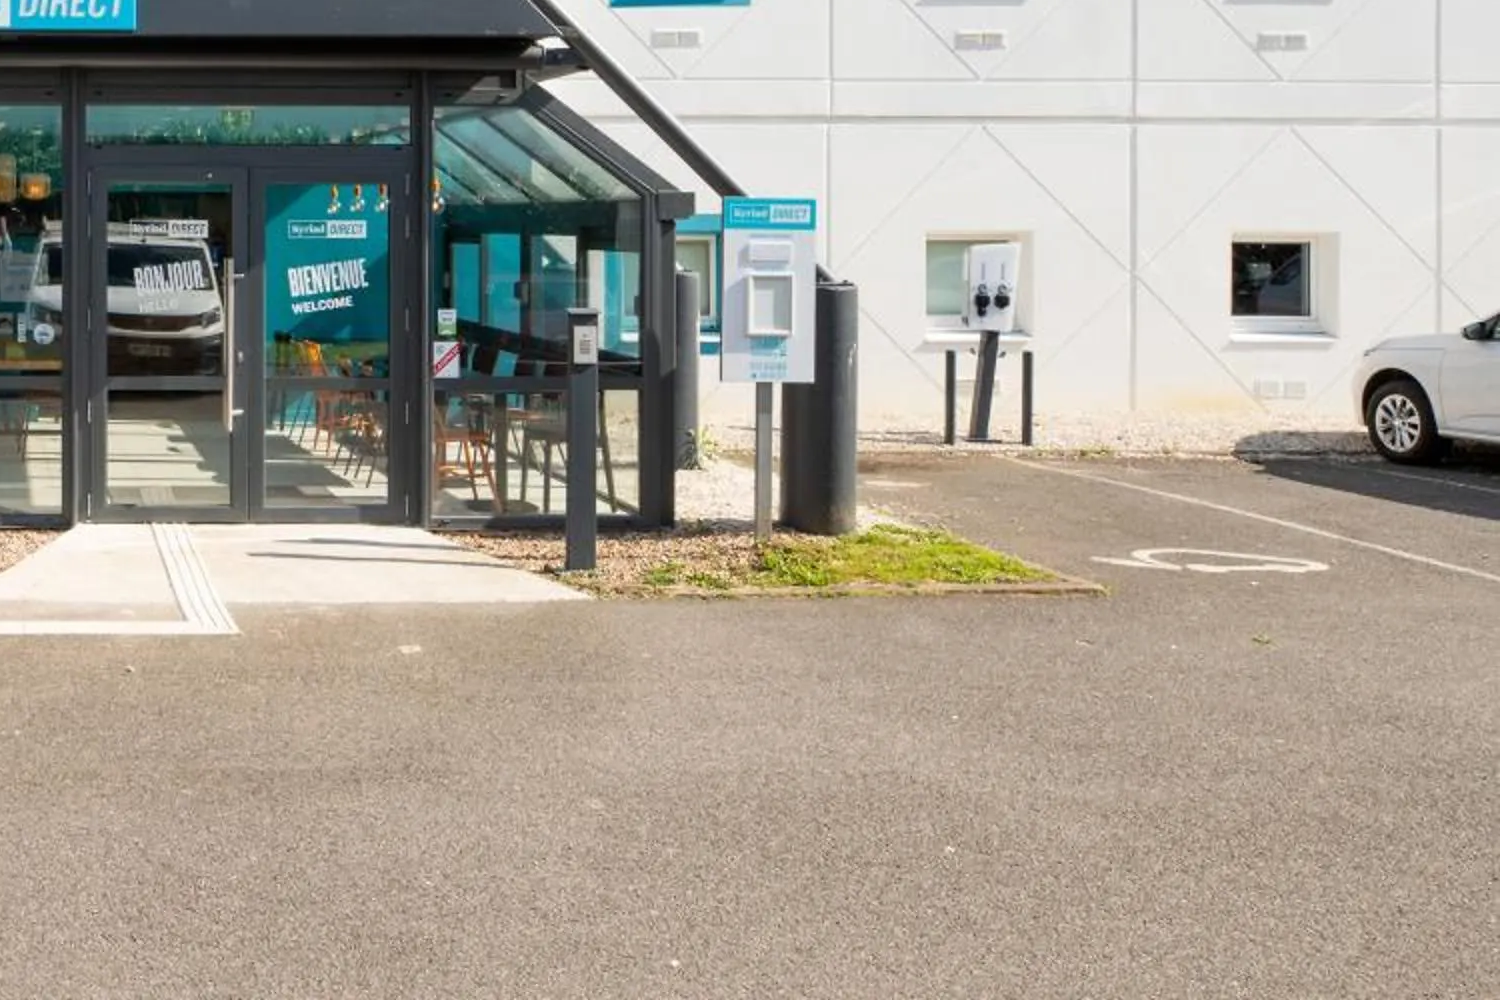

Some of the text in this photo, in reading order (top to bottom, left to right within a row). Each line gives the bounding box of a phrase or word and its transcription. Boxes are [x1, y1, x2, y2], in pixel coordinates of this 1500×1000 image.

[133, 260, 206, 297] BONJOUR
[287, 258, 369, 298] BIENVENUE
[291, 295, 354, 315] WELCOME
